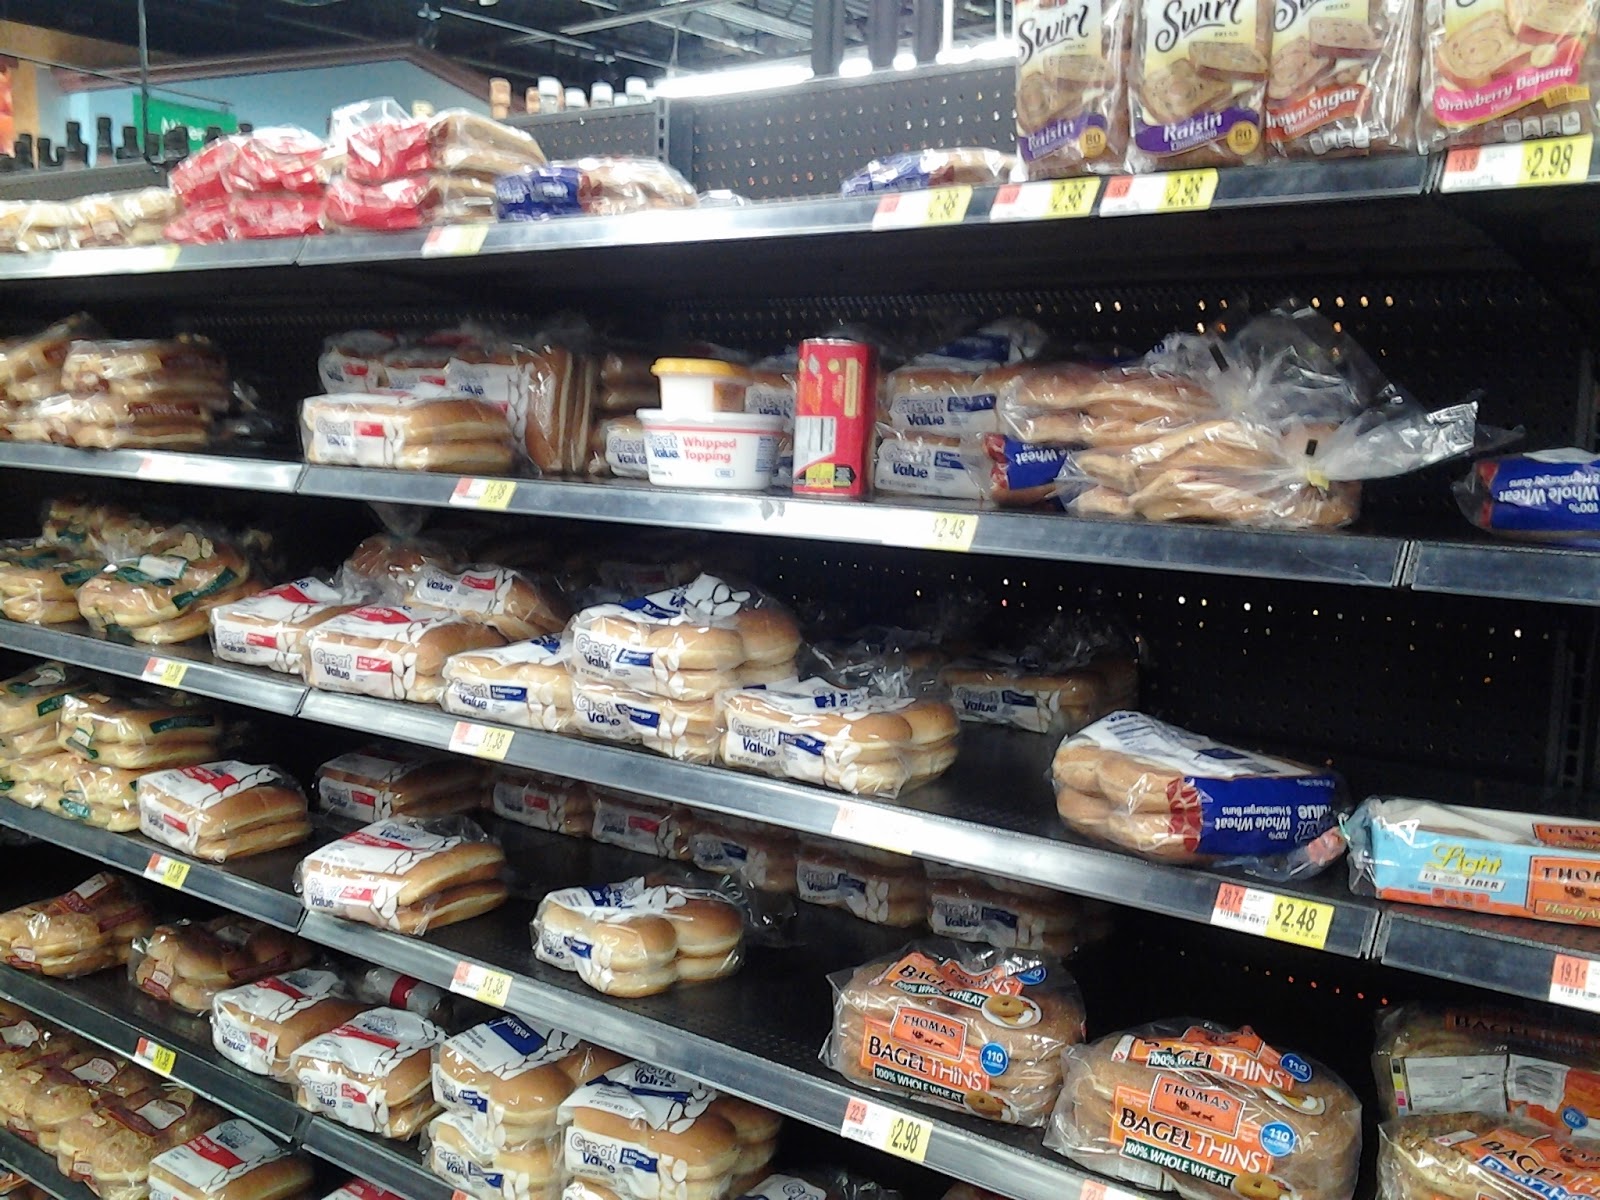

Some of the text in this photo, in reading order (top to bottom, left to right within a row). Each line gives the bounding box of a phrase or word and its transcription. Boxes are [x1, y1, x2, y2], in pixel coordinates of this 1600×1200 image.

[1019, 5, 1090, 65] Swirl
[1155, 0, 1242, 51] Swirl
[1437, 63, 1573, 112] Strawberry Banana
[1308, 90, 1360, 114] Sugar
[1027, 119, 1075, 149] Raisin
[1163, 112, 1223, 143] Raisin
[1527, 144, 1574, 179] $2.98
[906, 413, 944, 426] Value
[683, 436, 737, 450] Whipped
[684, 449, 732, 464] Topping
[1015, 448, 1057, 465] Wheat
[892, 463, 928, 479] Value
[1498, 485, 1599, 506] Whole Wheat
[1568, 502, 1599, 514] 100%
[426, 579, 453, 592] Value
[575, 633, 617, 660] Great
[313, 647, 353, 669] Great
[324, 665, 351, 681] Value
[460, 693, 488, 710] Value
[963, 699, 998, 713] Value
[732, 717, 776, 744] Great
[742, 737, 777, 757] Value
[1221, 805, 1243, 816] Buns
[1214, 815, 1291, 832] Whole Wheat
[1464, 878, 1499, 890] FIBER
[310, 895, 335, 909] Value
[1275, 901, 1318, 932] $2.48
[947, 990, 985, 1006] WHEAT
[902, 1014, 957, 1038] THOMAS
[868, 1035, 982, 1092] BAGEL THINS
[986, 1049, 1003, 1063] 110
[1150, 1051, 1176, 1067] 100%
[1287, 1059, 1307, 1072] 110
[1217, 1051, 1289, 1090] THINS
[301, 1075, 337, 1097] Great
[875, 1066, 963, 1102] 100% WHOLE WHEAT
[1164, 1081, 1232, 1112] THOMAS
[891, 1118, 921, 1154] $2.98
[1119, 1106, 1265, 1174] BAGEL THINS
[1268, 1127, 1289, 1141] 110
[570, 1131, 618, 1164] Great
[1124, 1141, 1234, 1187] 100% WHOLE WHEAT
[1481, 1140, 1563, 1181] BAGEL
